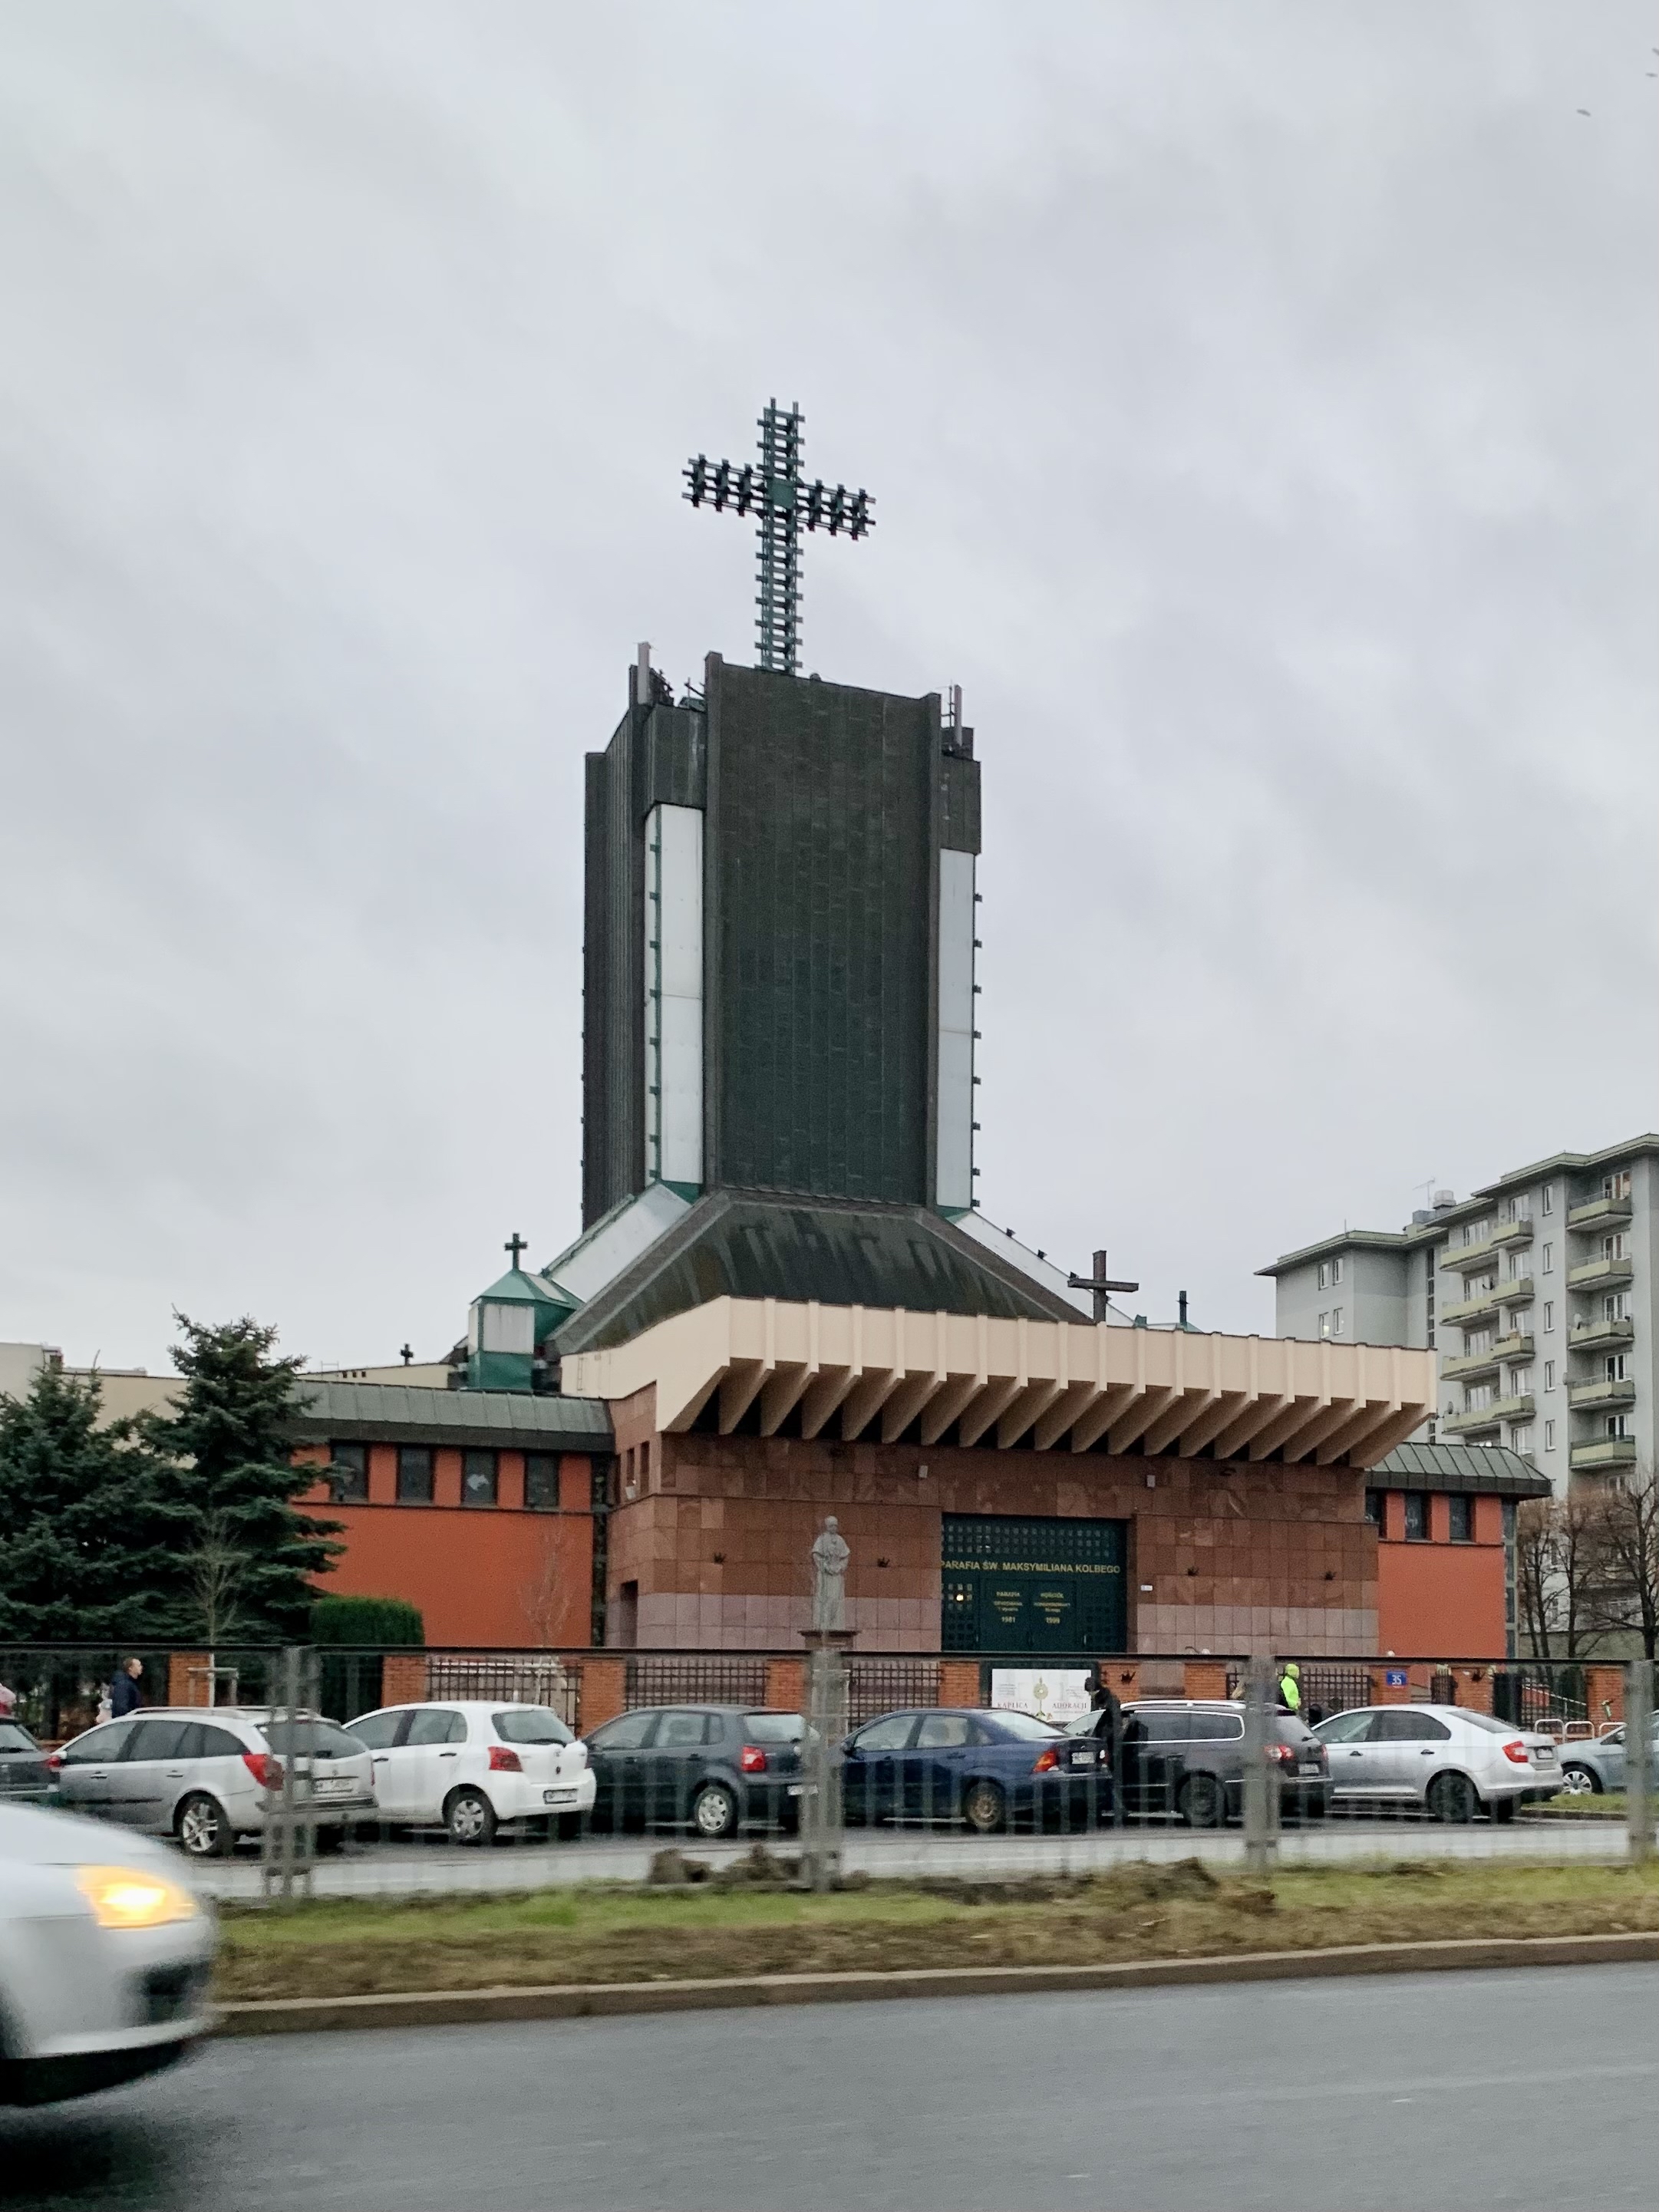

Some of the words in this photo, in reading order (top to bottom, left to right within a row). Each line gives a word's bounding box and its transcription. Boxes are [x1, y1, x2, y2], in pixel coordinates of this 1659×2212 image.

[941, 1561, 980, 1570] PARAFIA
[1002, 1562, 1074, 1572] MAKSYMILIANA
[1076, 1564, 1120, 1574] KOLBEGO
[1392, 1674, 1402, 1685] 35
